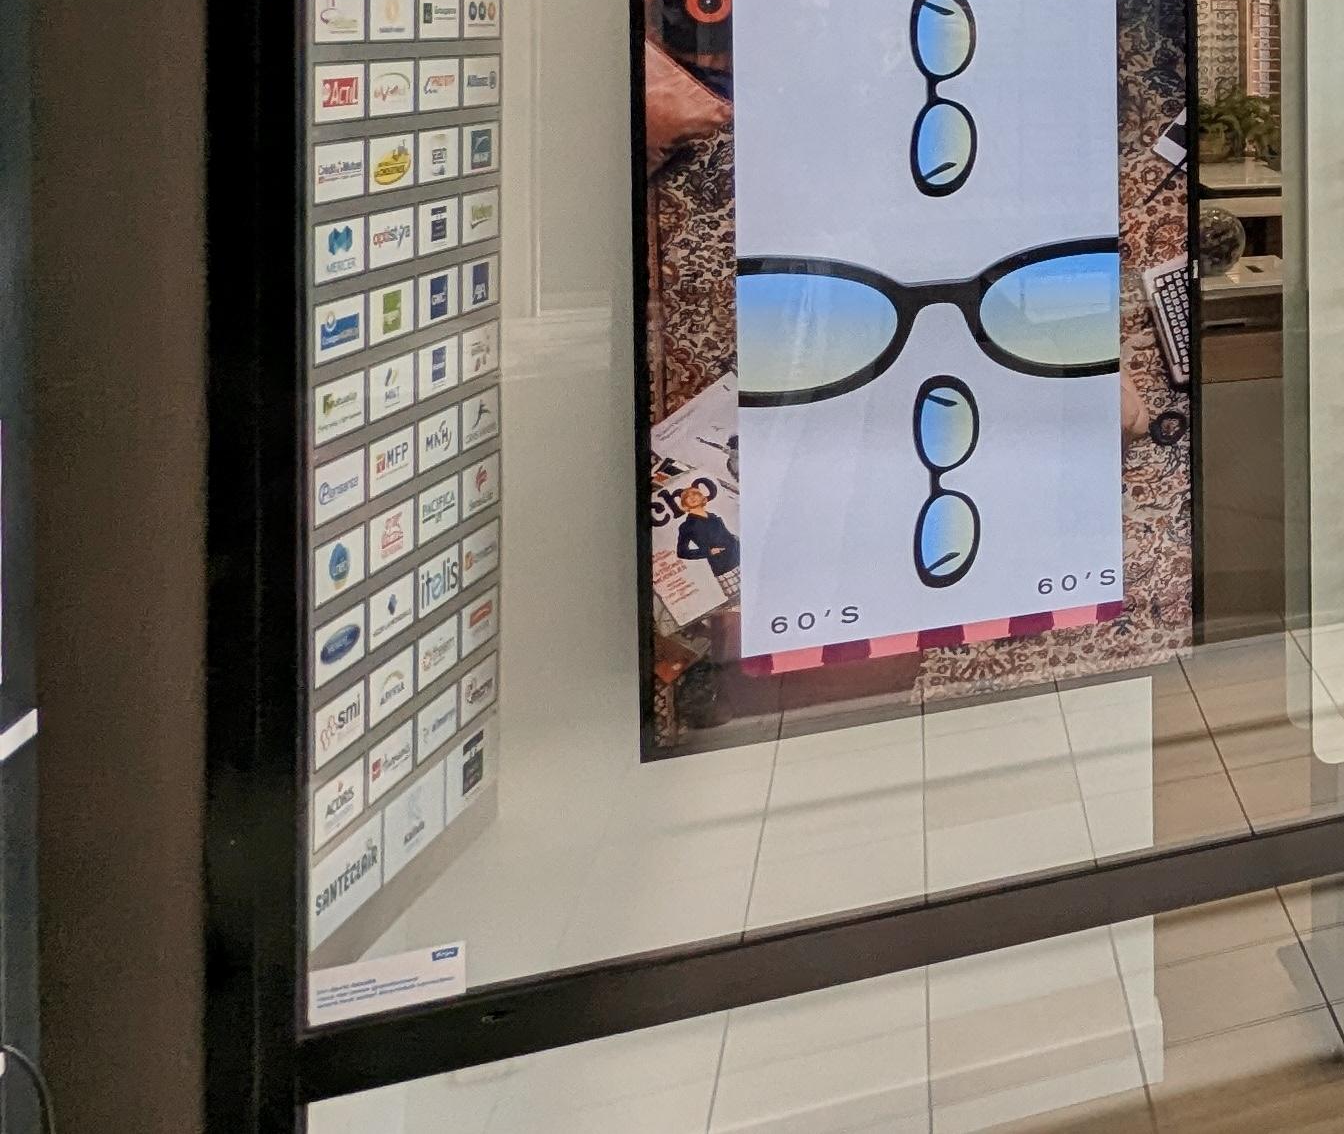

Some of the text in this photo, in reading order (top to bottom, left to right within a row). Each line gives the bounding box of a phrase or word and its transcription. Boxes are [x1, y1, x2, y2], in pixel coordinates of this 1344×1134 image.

[386, 442, 409, 468] MFP
[422, 491, 455, 517] PACIFICA
[421, 557, 458, 610] itelis
[1038, 569, 1116, 595] 60'S
[770, 606, 860, 634] 60'S
[337, 693, 361, 729] smi
[315, 843, 378, 917] SANTÉCLAIR
